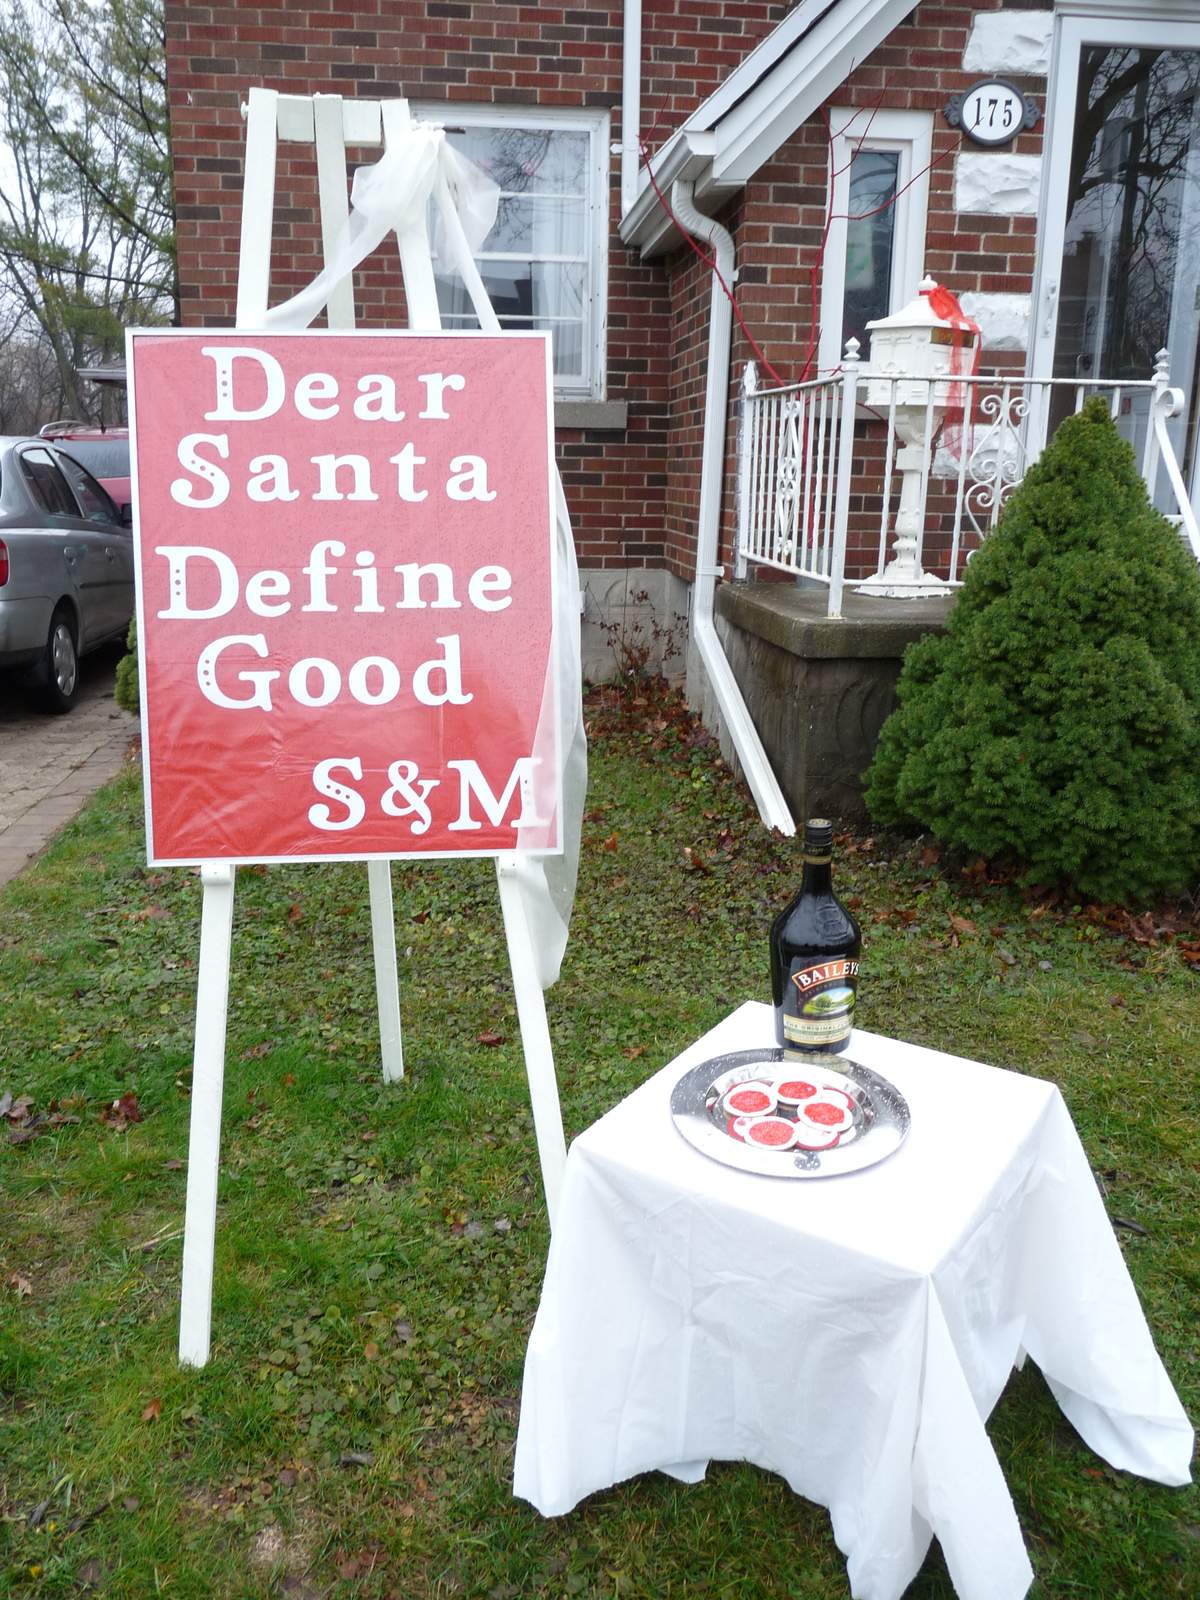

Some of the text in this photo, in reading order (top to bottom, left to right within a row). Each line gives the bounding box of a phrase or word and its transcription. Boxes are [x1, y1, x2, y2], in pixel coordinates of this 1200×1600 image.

[975, 97, 1013, 127] 175
[201, 346, 466, 422] Dear
[169, 433, 497, 509] Santa
[154, 539, 513, 620] Define
[197, 633, 473, 712] Good
[307, 756, 550, 836] S&M
[798, 961, 860, 986] BAILEYS
